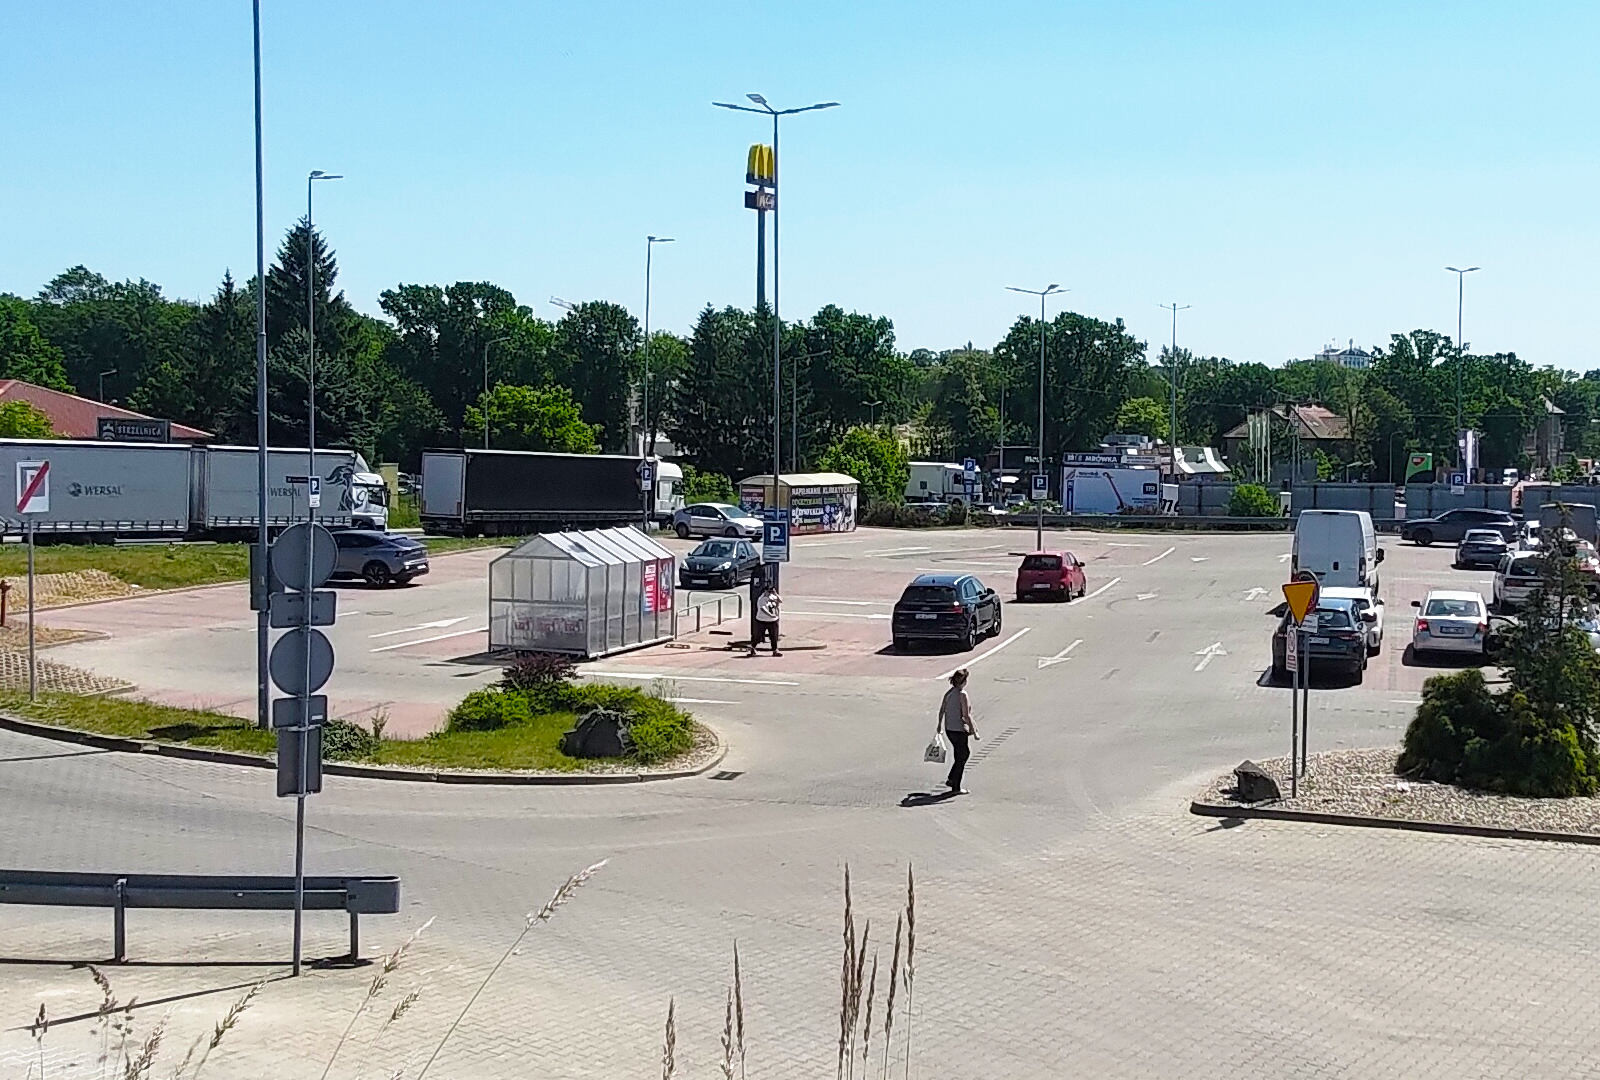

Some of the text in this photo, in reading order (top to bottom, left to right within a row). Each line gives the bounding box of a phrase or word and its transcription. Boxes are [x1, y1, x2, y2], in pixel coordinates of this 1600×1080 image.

[84, 485, 122, 496] WERSAL
[270, 487, 301, 497] WERSAL
[770, 526, 781, 542] P
